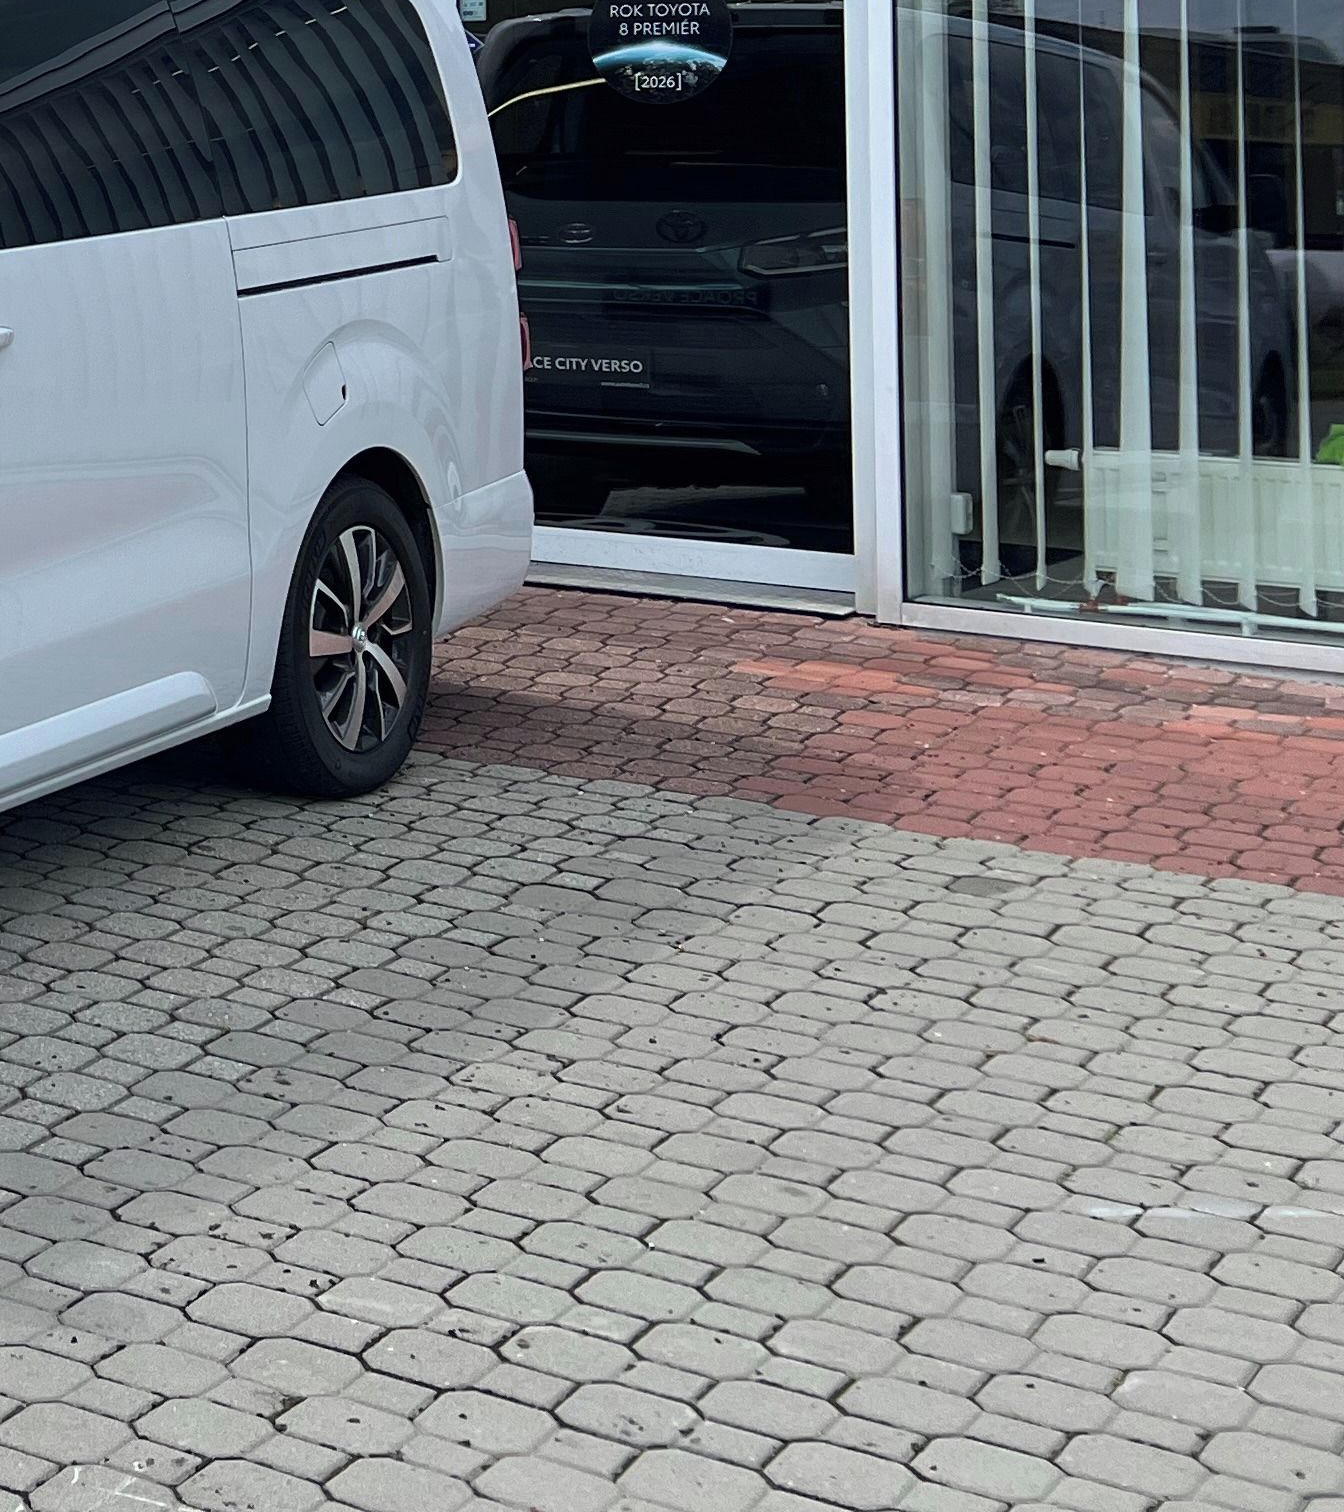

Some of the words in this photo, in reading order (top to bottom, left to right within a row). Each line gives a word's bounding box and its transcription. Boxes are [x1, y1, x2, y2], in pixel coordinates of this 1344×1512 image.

[609, 4, 643, 18] ROK
[647, 3, 710, 17] TOYOTA
[619, 23, 629, 36] 8
[633, 19, 700, 35] PREMIÉR
[555, 357, 588, 371] CITY
[590, 359, 643, 373] VERSO
